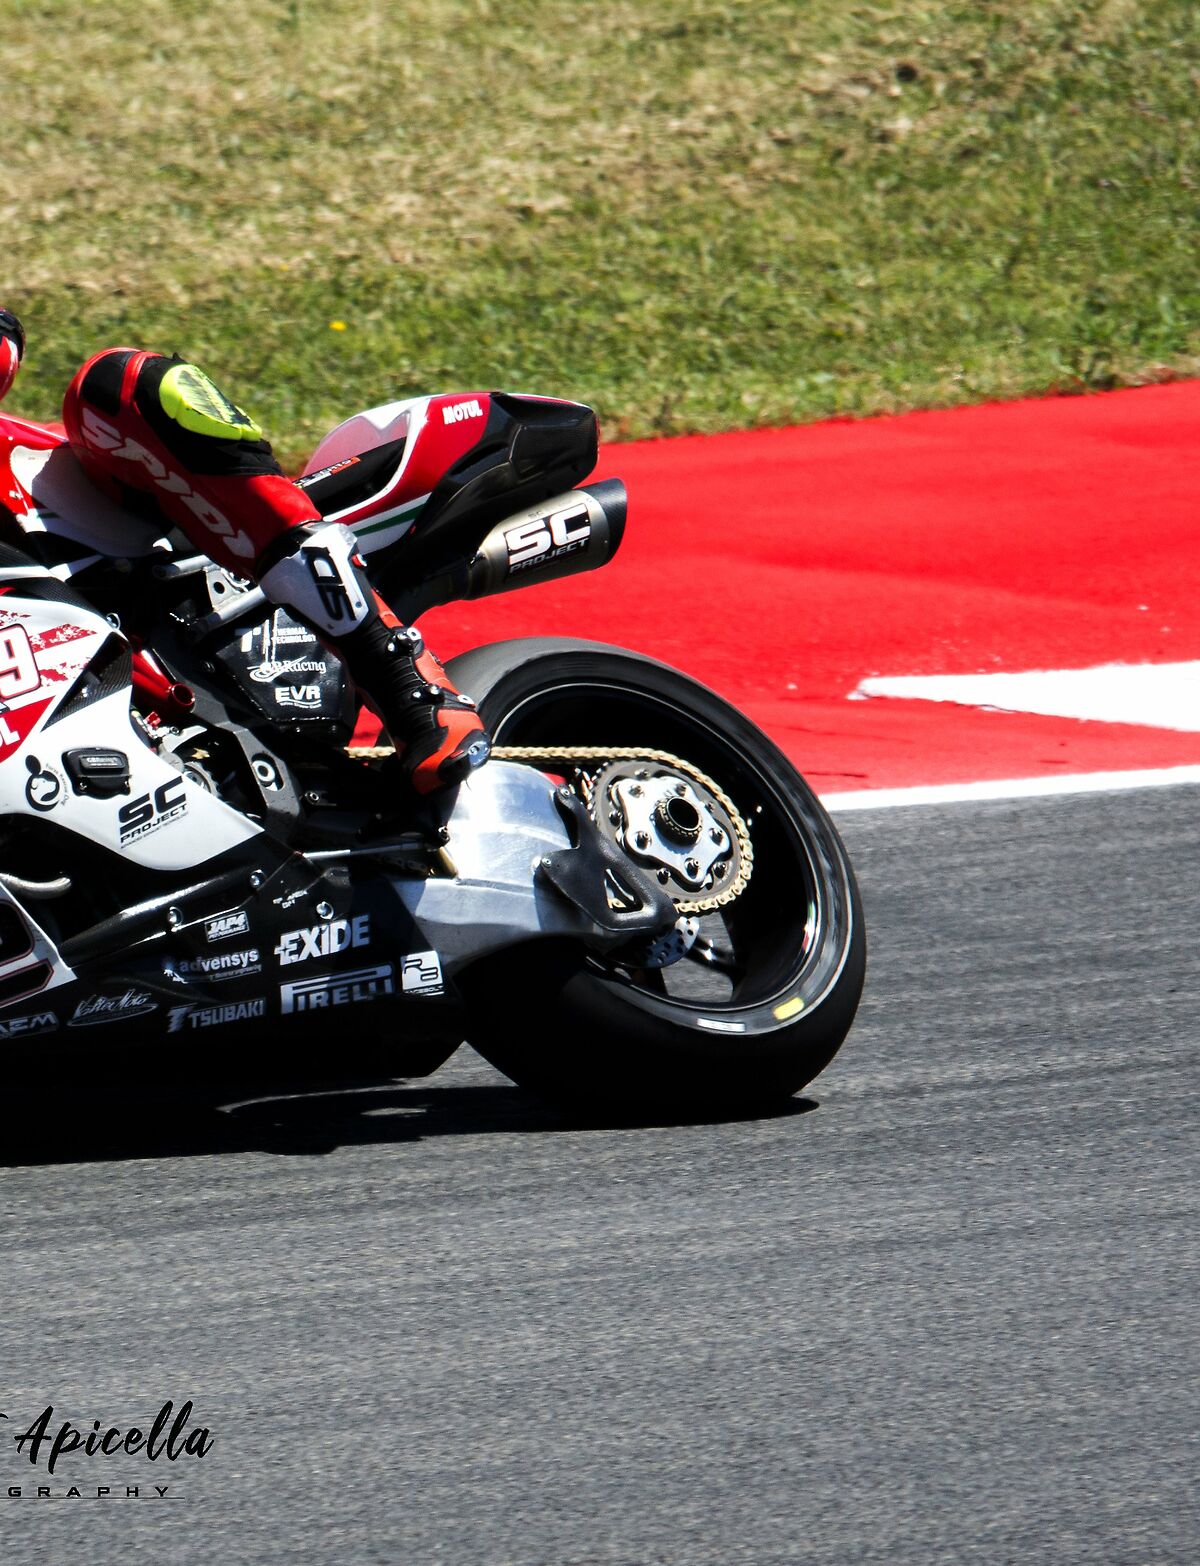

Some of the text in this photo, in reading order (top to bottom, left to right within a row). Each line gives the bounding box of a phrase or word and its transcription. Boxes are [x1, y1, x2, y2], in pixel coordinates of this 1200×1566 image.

[442, 400, 484, 425] MOTUL
[81, 407, 256, 559] SPIDI
[504, 503, 591, 565] SC
[509, 538, 589, 574] PROJECT
[275, 685, 321, 701] EVR
[118, 775, 187, 836] SC
[120, 803, 188, 844] PROJECT
[179, 948, 260, 973] advensys
[274, 914, 371, 966] EXIDE
[280, 962, 394, 1015] PIRELLI
[187, 998, 266, 1029] TSUBAKI
